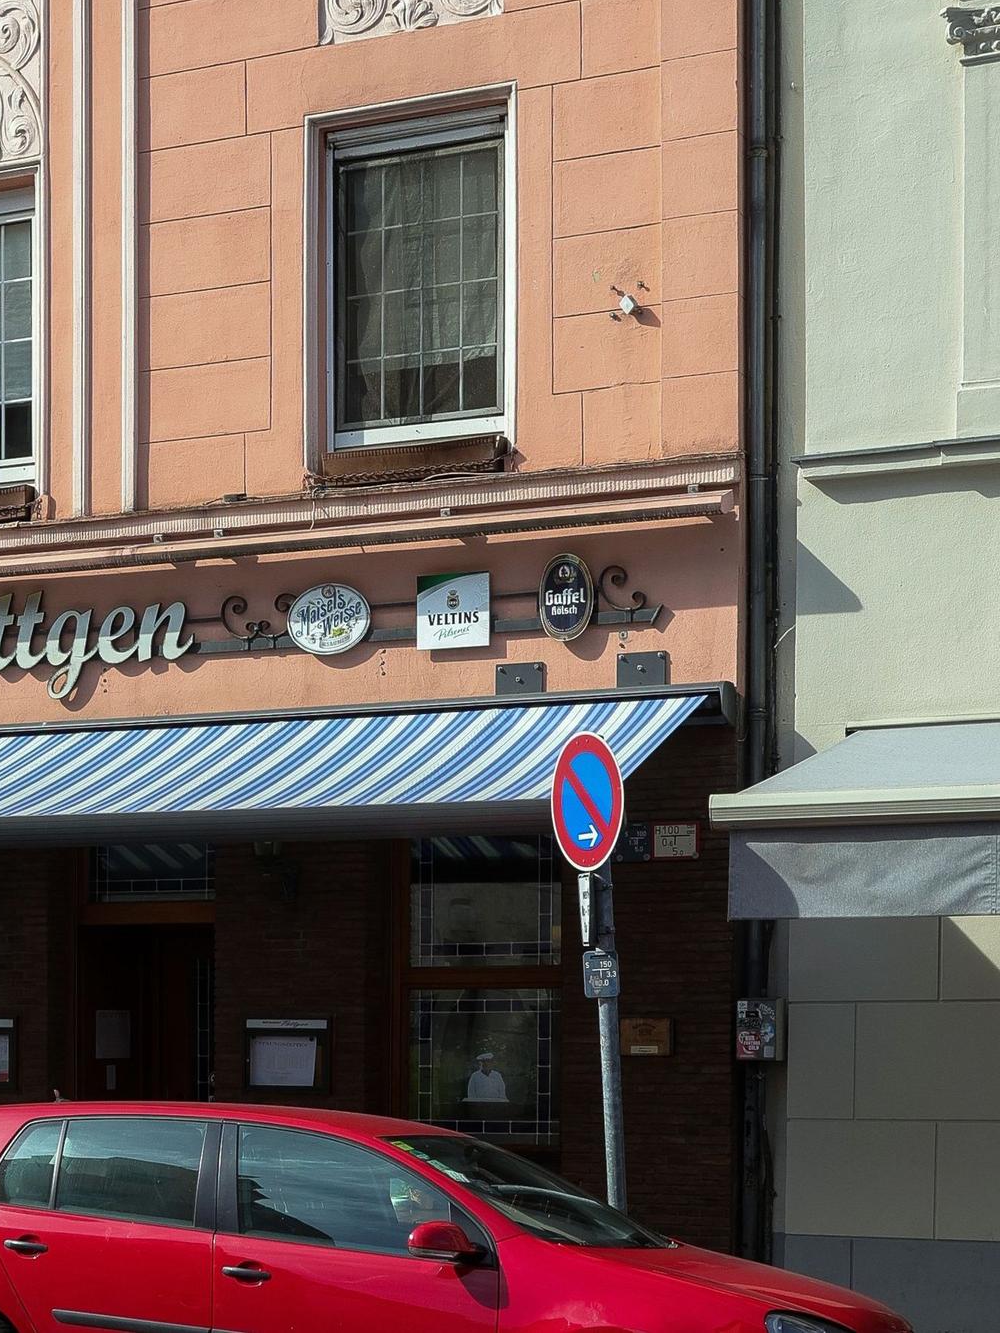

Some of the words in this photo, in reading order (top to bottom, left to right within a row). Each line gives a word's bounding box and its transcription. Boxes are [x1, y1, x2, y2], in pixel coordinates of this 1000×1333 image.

[545, 587, 587, 606] Gaffel
[551, 605, 578, 616] Kölsch
[317, 601, 362, 638] Weisse
[427, 609, 480, 627] VELTINS
[662, 825, 680, 835] 100
[585, 961, 590, 969] S
[599, 960, 612, 969] 150
[606, 970, 617, 978] 3.3
